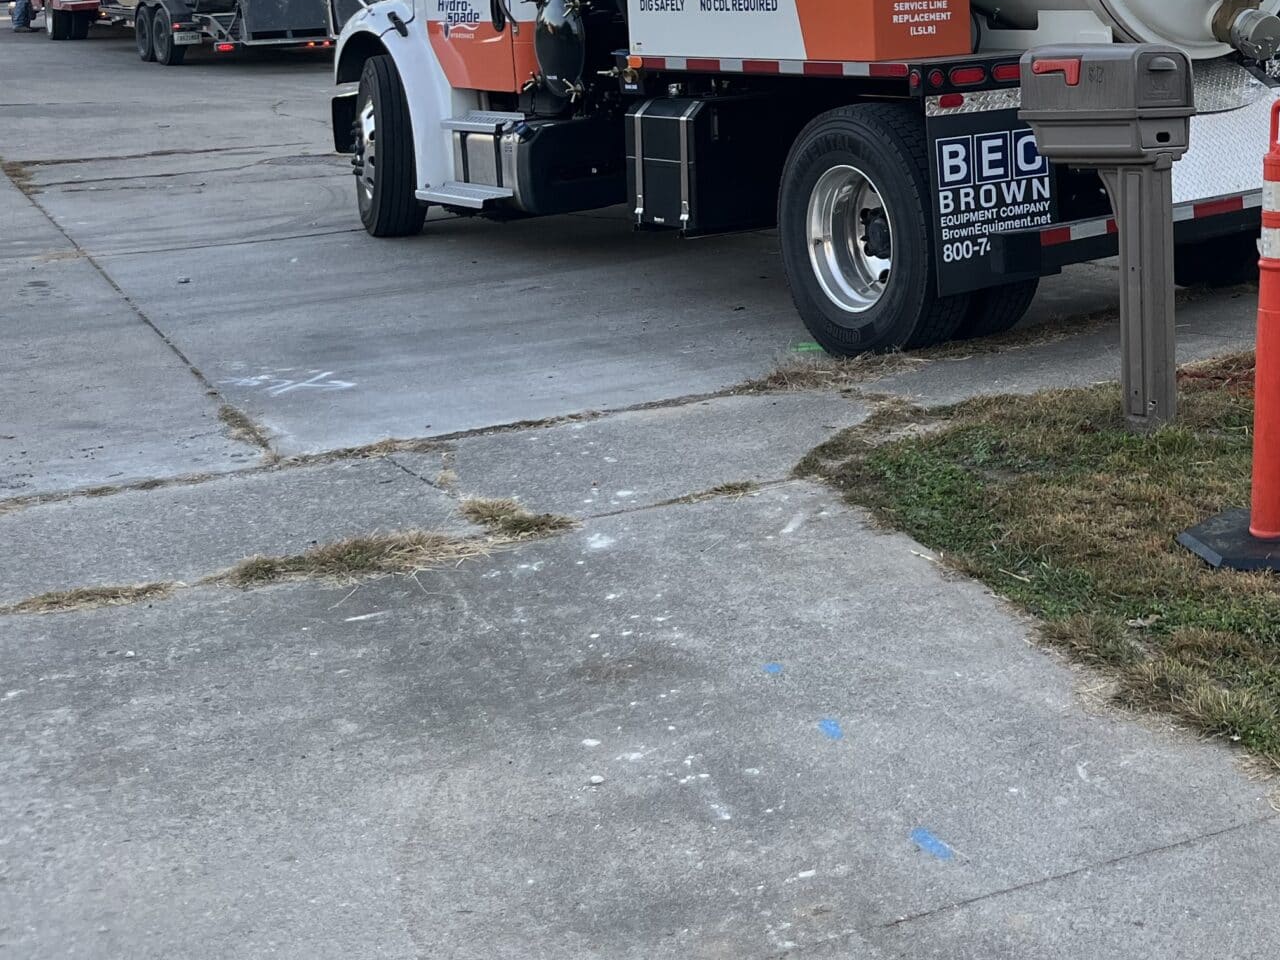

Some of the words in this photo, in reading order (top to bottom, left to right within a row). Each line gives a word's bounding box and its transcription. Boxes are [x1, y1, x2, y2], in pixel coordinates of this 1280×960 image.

[447, 9, 480, 26] spade
[892, 12, 951, 23] REPLACEMENT
[893, 1, 928, 11] SERVICE
[929, 0, 948, 9] LINE
[941, 135, 1042, 182] BEC
[940, 177, 1051, 214] BROWN
[941, 208, 998, 227] EQUIPMENT
[1000, 201, 1051, 217] COMPANY
[942, 213, 1051, 240] BrownEquipment.net
